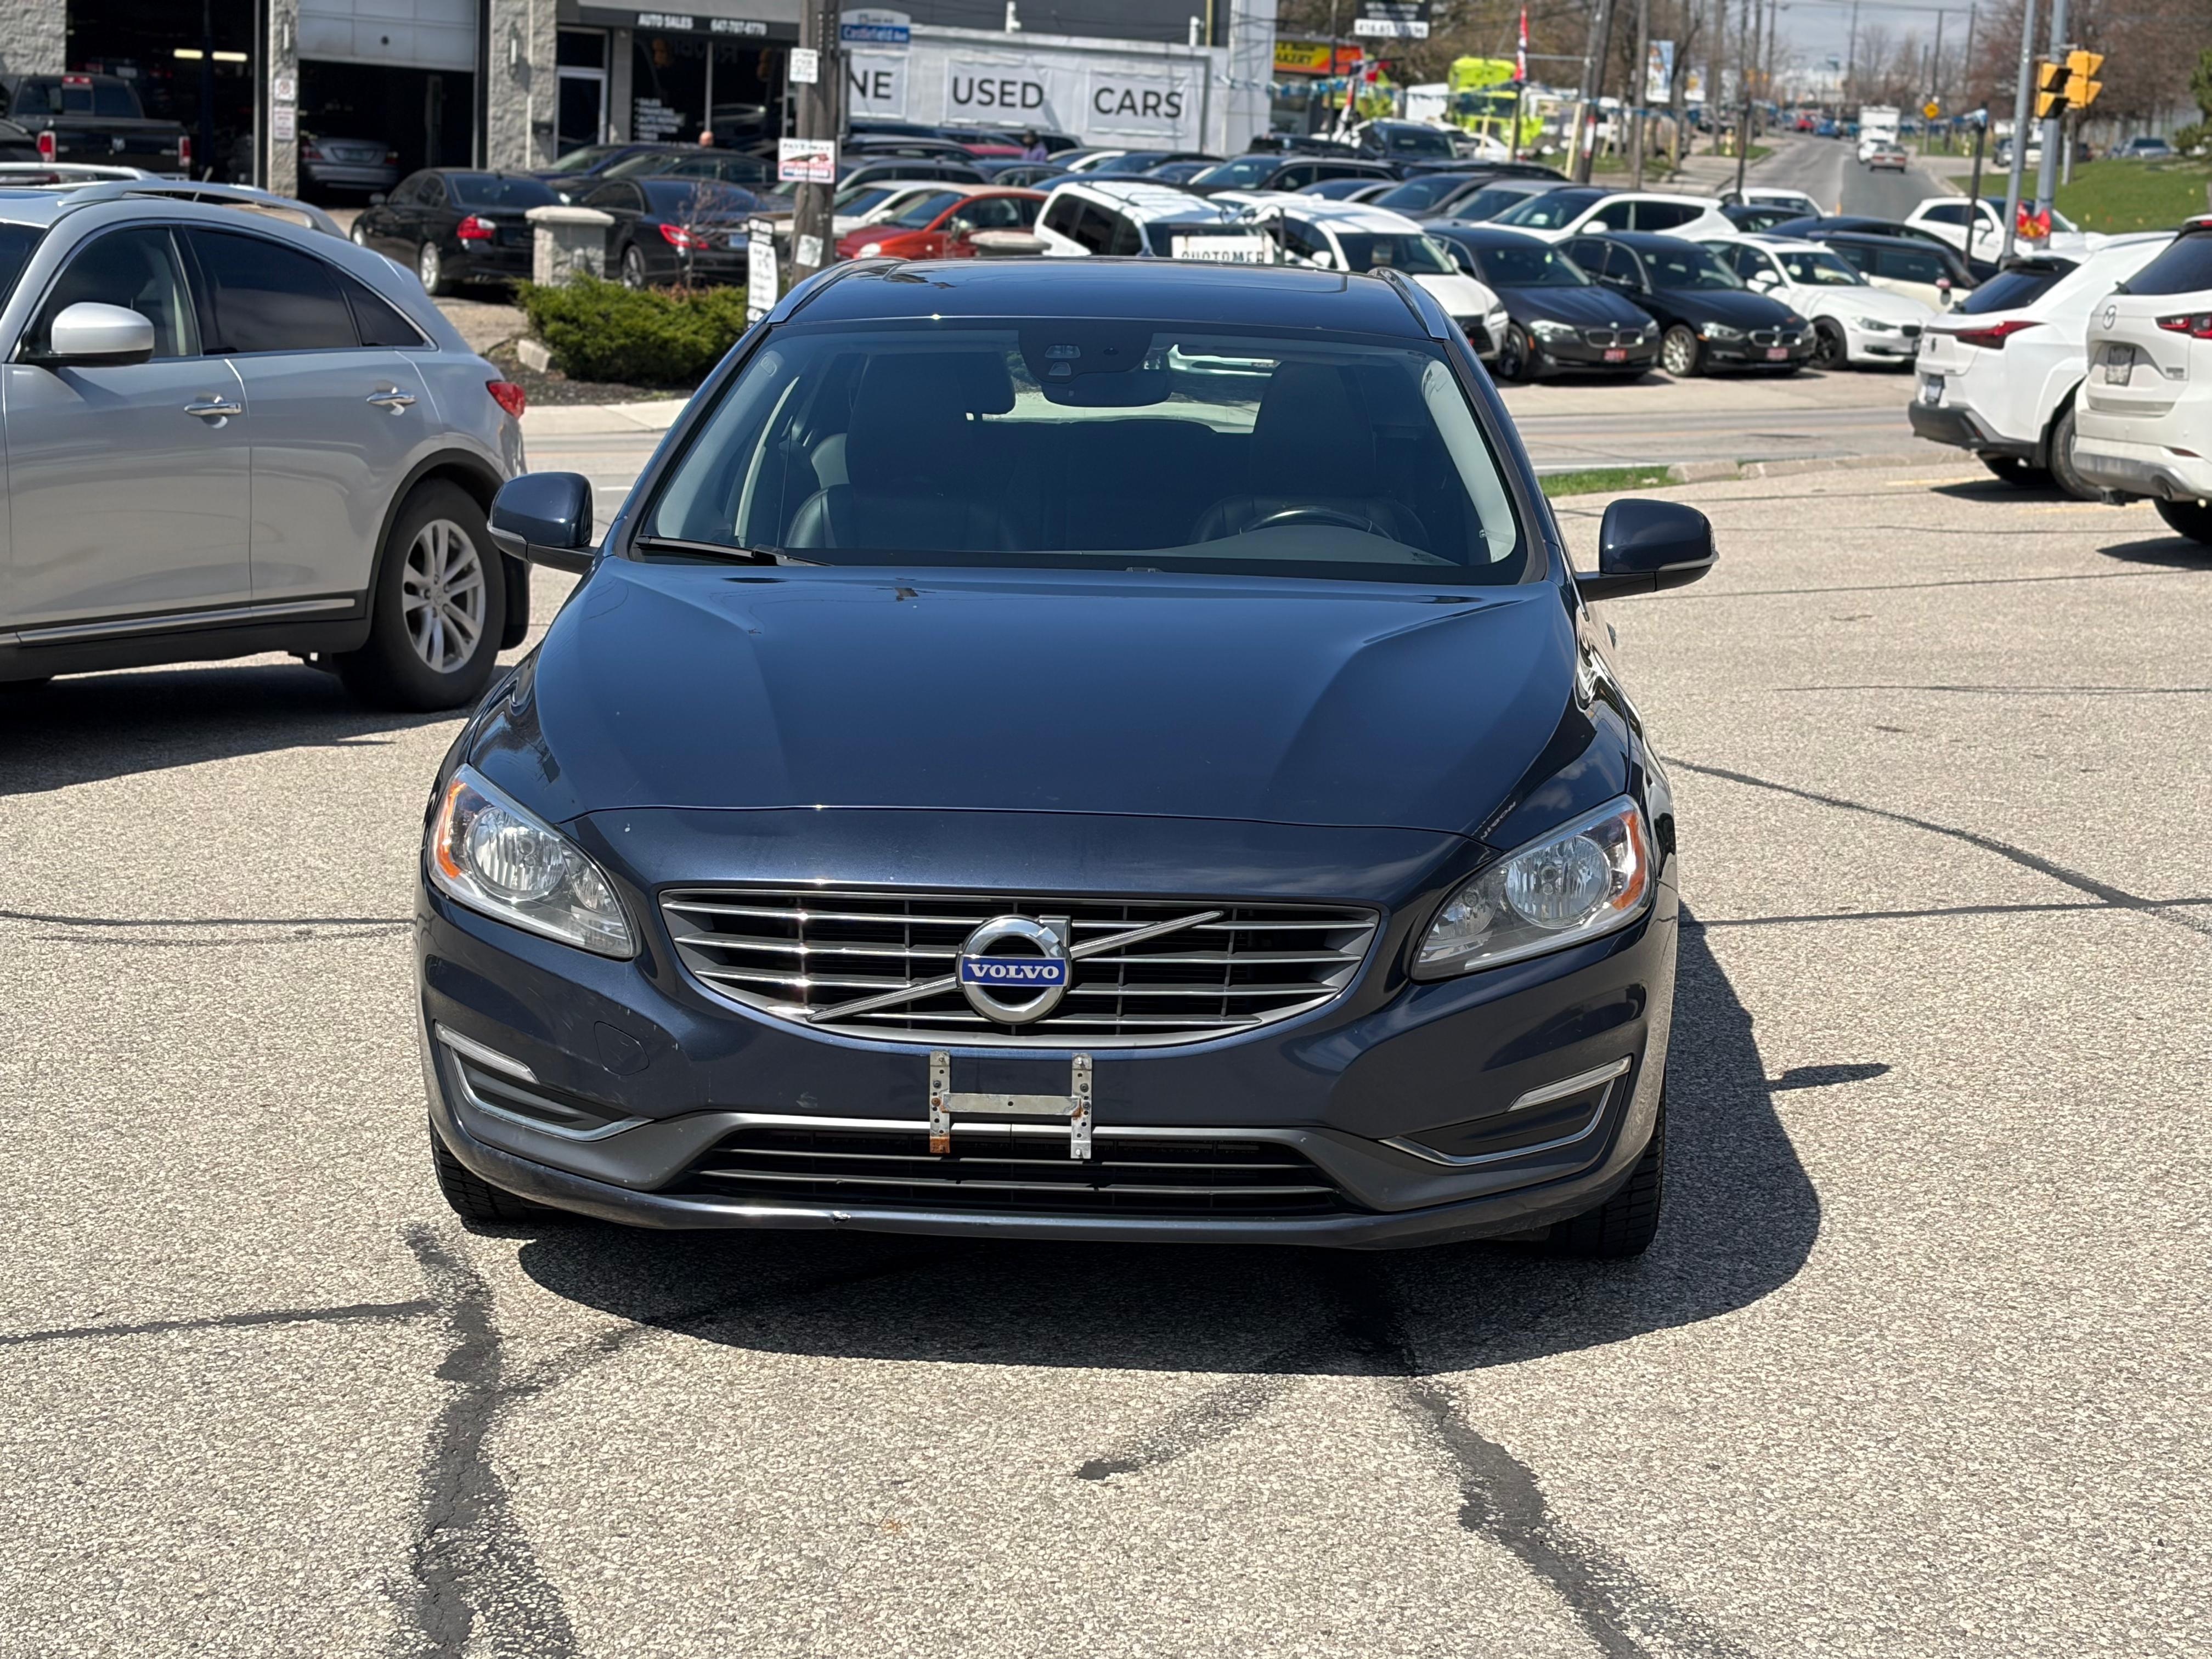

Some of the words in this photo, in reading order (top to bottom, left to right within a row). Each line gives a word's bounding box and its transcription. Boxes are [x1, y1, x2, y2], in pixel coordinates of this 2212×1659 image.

[637, 13, 663, 27] AUTO
[664, 15, 693, 30] SALES
[1274, 54, 1313, 65] AKERY
[850, 70, 893, 99] NE
[953, 76, 1043, 109] USED
[1094, 87, 1183, 119] CARS
[968, 963, 1059, 979] VOLVO
